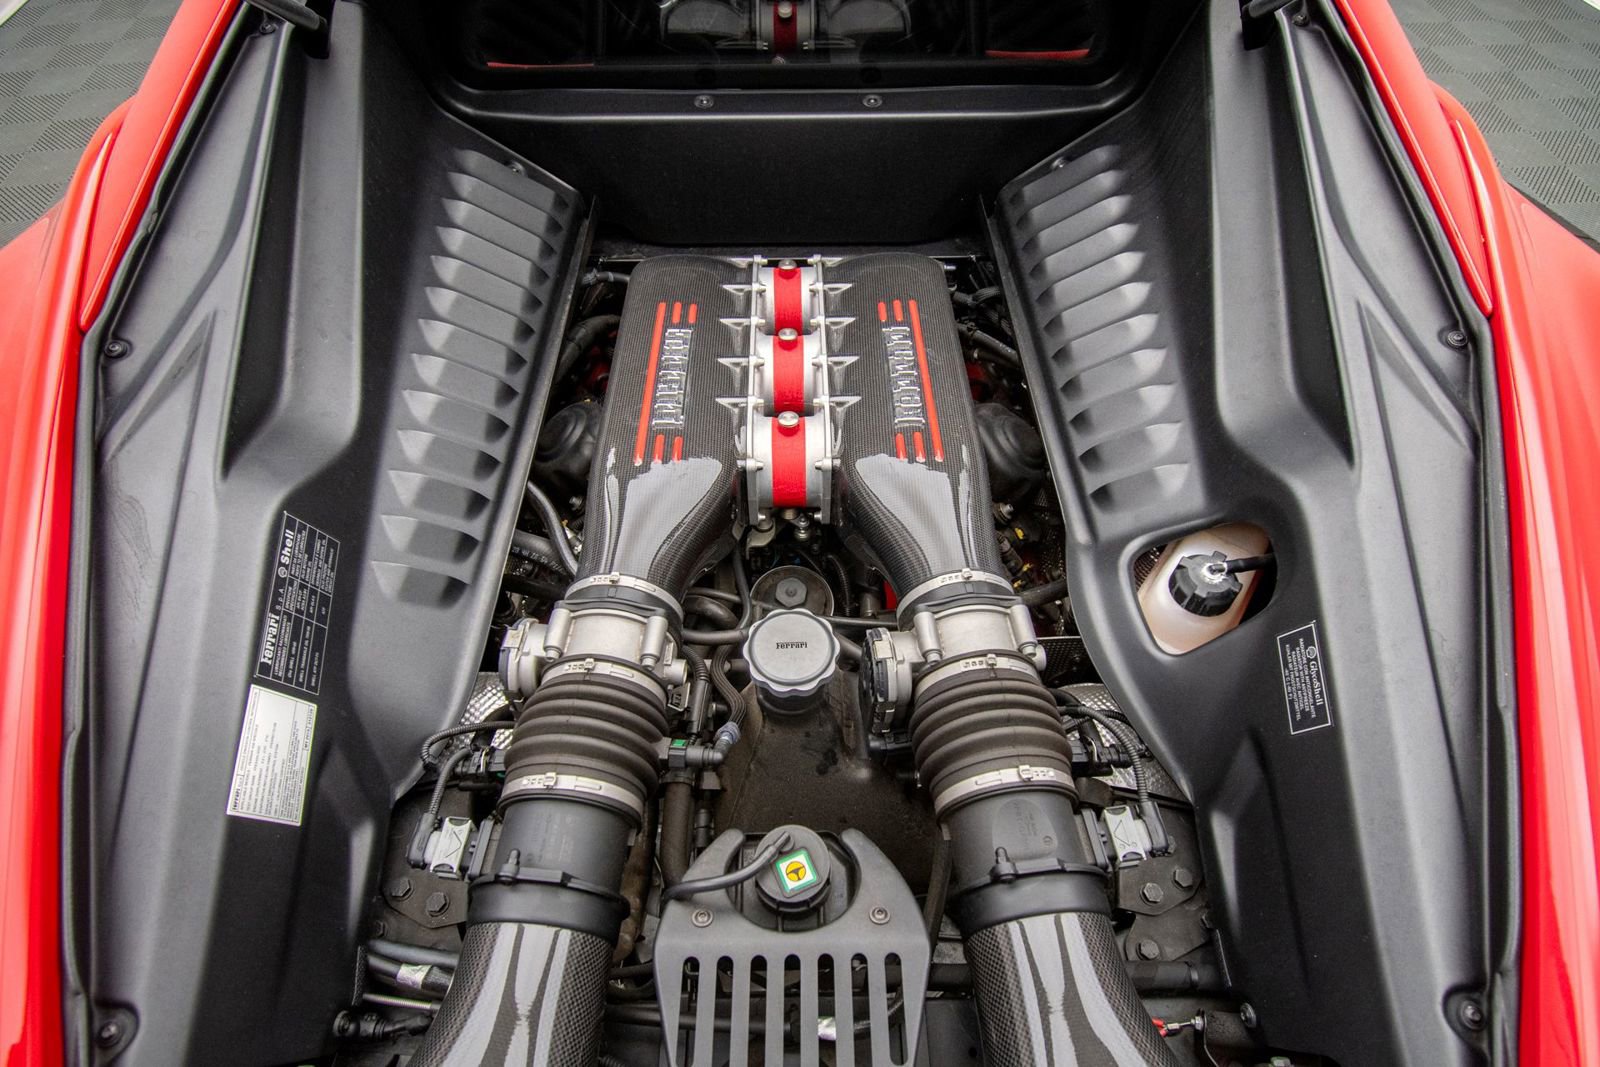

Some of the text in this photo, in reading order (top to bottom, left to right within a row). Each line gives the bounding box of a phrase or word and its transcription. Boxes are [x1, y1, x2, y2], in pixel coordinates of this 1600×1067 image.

[281, 529, 294, 565] Shell
[261, 612, 280, 665] Ferrari
[776, 641, 808, 649] Ferrari
[1291, 651, 1299, 677] RADIATEUR
[1299, 638, 1307, 664] RADIATORE
[1305, 675, 1316, 718] ANTICONGELANTE
[1301, 683, 1310, 712] ANTIFREEZE
[1309, 661, 1324, 706] GlycoShell
